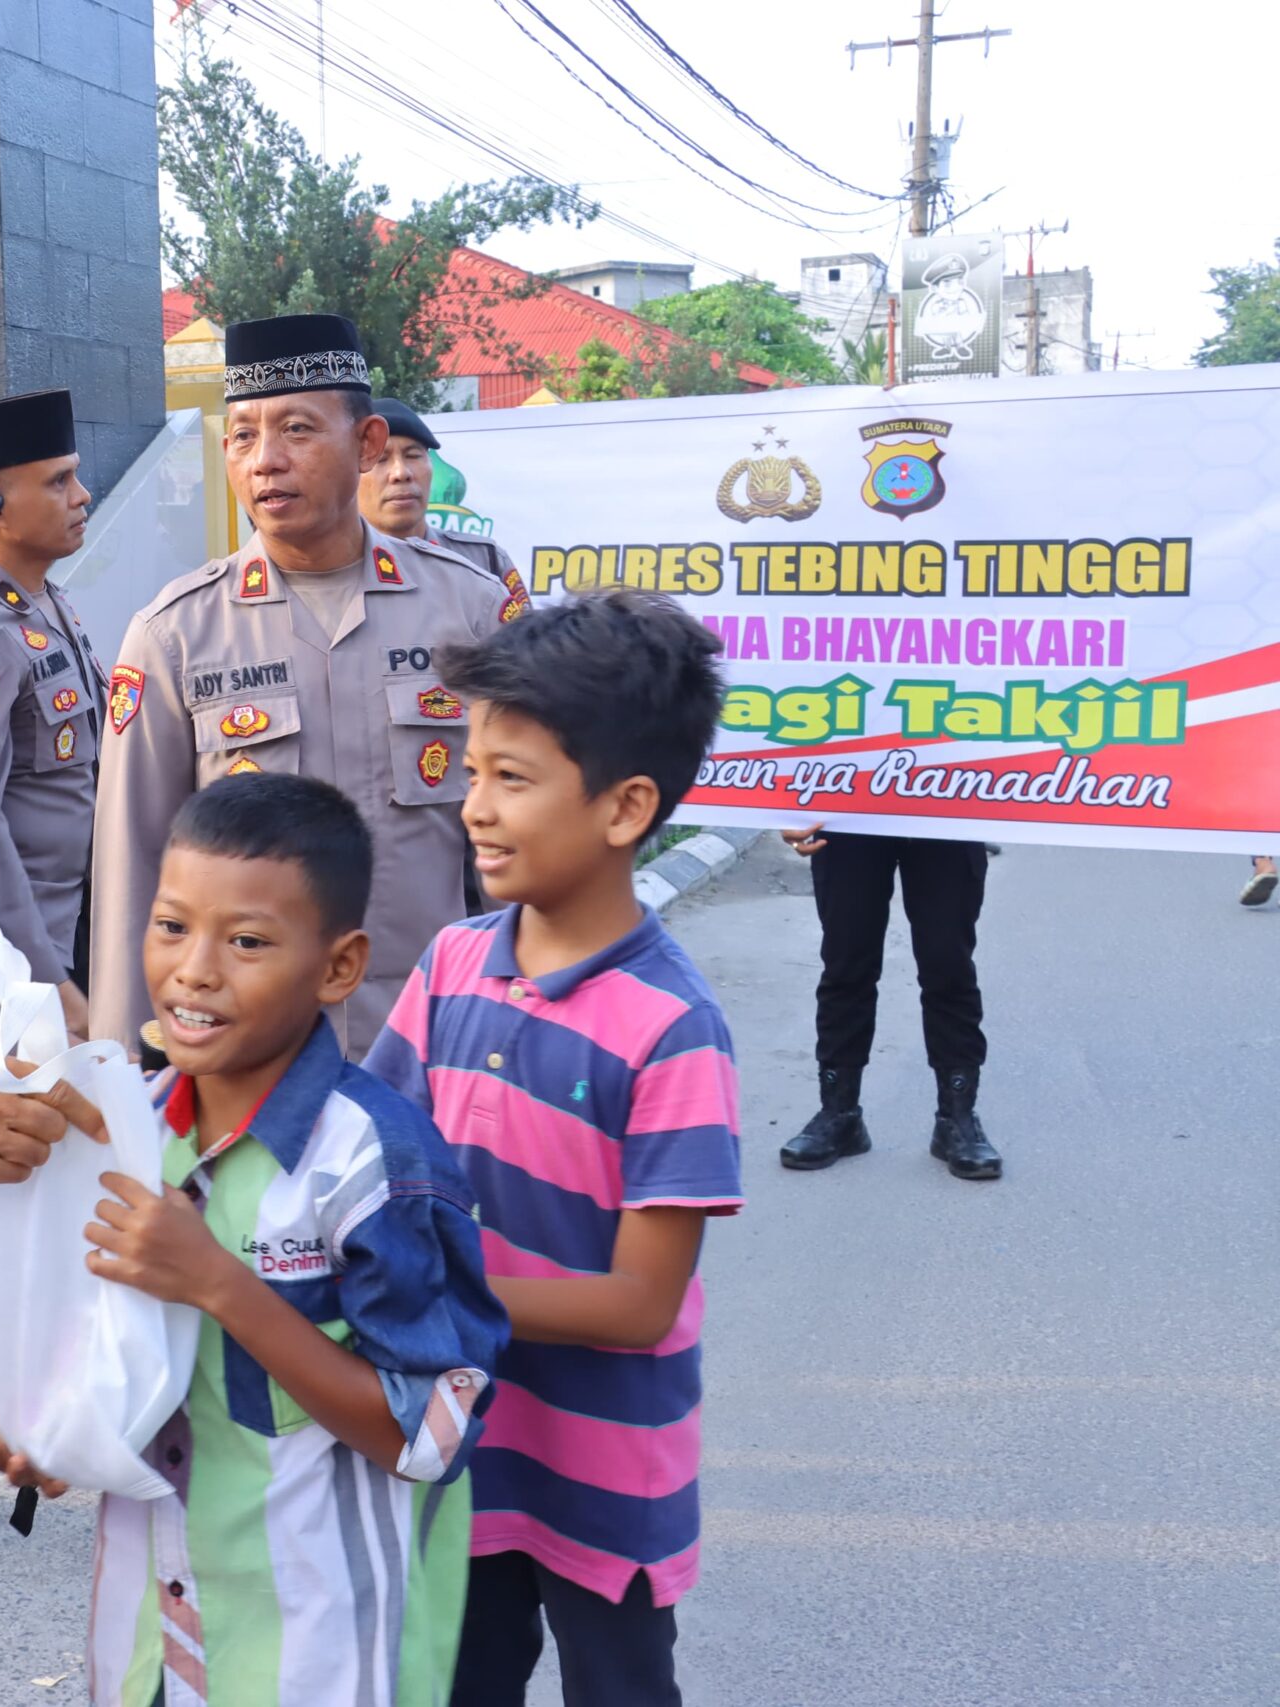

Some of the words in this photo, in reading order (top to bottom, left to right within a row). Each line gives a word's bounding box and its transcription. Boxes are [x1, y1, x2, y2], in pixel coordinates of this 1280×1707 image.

[863, 421, 914, 438] SUMATERA
[915, 421, 948, 434] UTARA
[532, 543, 723, 597] POLRES
[730, 541, 947, 597] TEBING
[954, 537, 1193, 598] TINGGI
[781, 615, 1125, 666] BHAYANGKARI
[194, 671, 223, 699] ADY
[230, 661, 288, 691] SANTRI
[883, 677, 1189, 754] Takjil
[785, 760, 858, 806] ya
[869, 748, 1171, 808] Ramadhan
[241, 1233, 272, 1255] Lee
[260, 1253, 326, 1273] Denim
